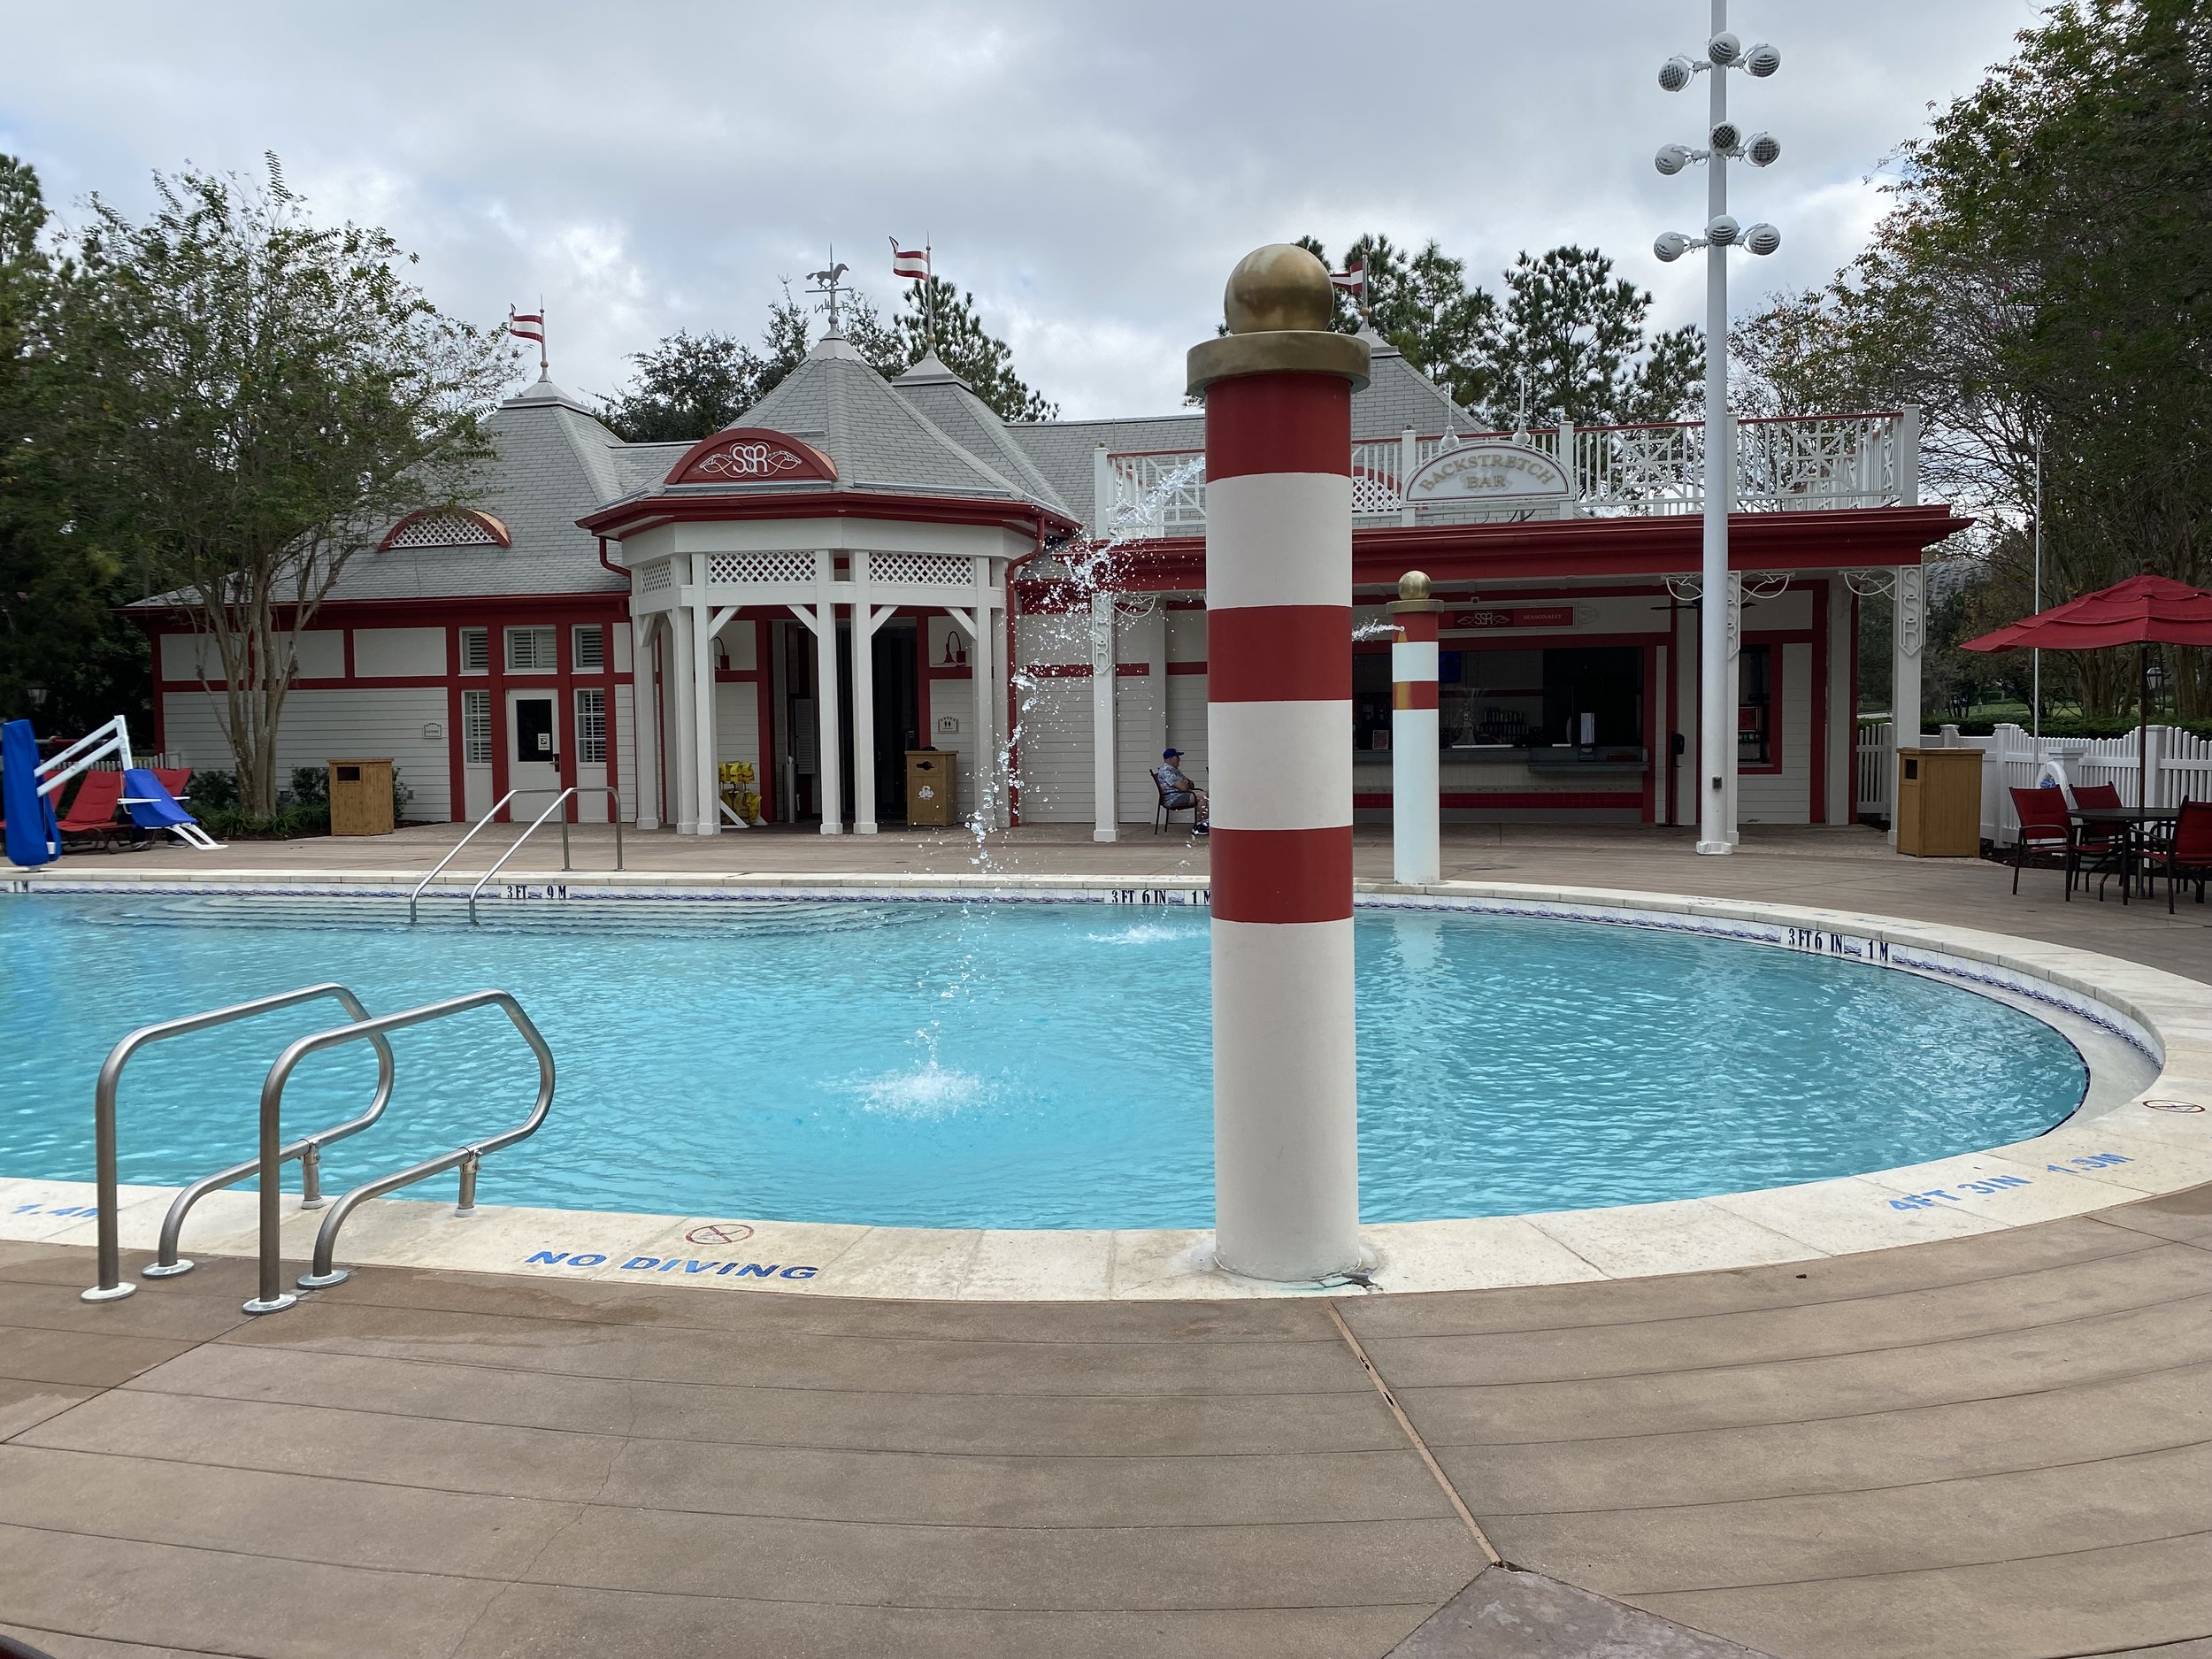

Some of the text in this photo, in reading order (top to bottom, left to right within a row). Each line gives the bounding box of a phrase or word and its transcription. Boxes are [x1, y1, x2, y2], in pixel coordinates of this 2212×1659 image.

[1419, 454, 1556, 491] BACKSTRETCH
[1466, 475, 1507, 489] BAR
[507, 885, 567, 899] 3 FT 9 M
[1111, 890, 1118, 903] 3
[1121, 890, 1135, 903] FT
[1142, 890, 1150, 903] 6
[1154, 890, 1167, 904] IN
[1192, 891, 1197, 904] 1
[1788, 928, 1889, 961] 3 FT 6 IN 1 M
[1888, 1189, 1962, 1212] 4FT
[1957, 1174, 2033, 1194] 3IN
[525, 1250, 820, 1279] NO DIVING
